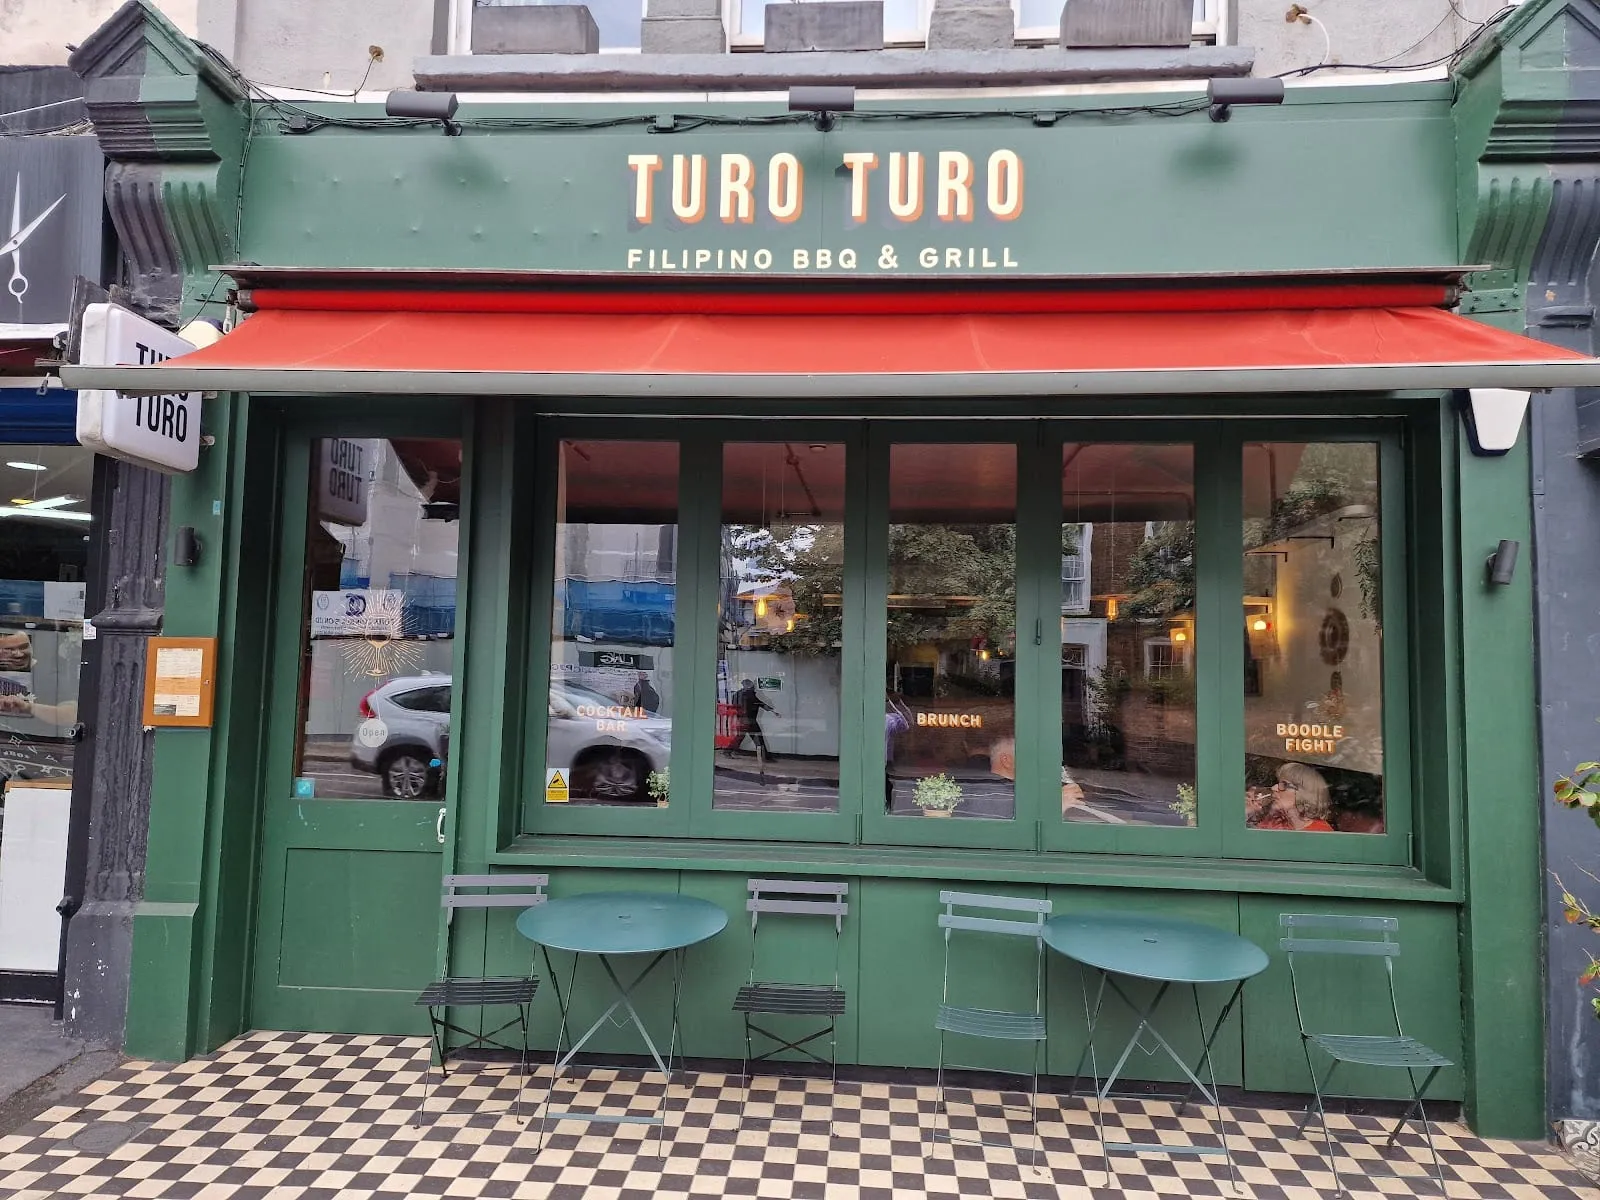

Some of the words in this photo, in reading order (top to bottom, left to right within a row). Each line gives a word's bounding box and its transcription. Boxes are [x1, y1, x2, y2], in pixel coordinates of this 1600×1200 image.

[628, 153, 803, 223] TURO
[843, 149, 1024, 222] TURO
[627, 249, 773, 269] FILIPINO
[793, 248, 857, 269] BBQ
[878, 244, 899, 269] &
[919, 247, 1018, 268] GRILL
[576, 705, 648, 719] COCKTAIL
[596, 719, 628, 732] BAR
[917, 712, 983, 728] BRUNCH
[362, 727, 385, 738] Open
[1276, 723, 1343, 738] BOODLE
[1285, 738, 1336, 753] FIGHT
